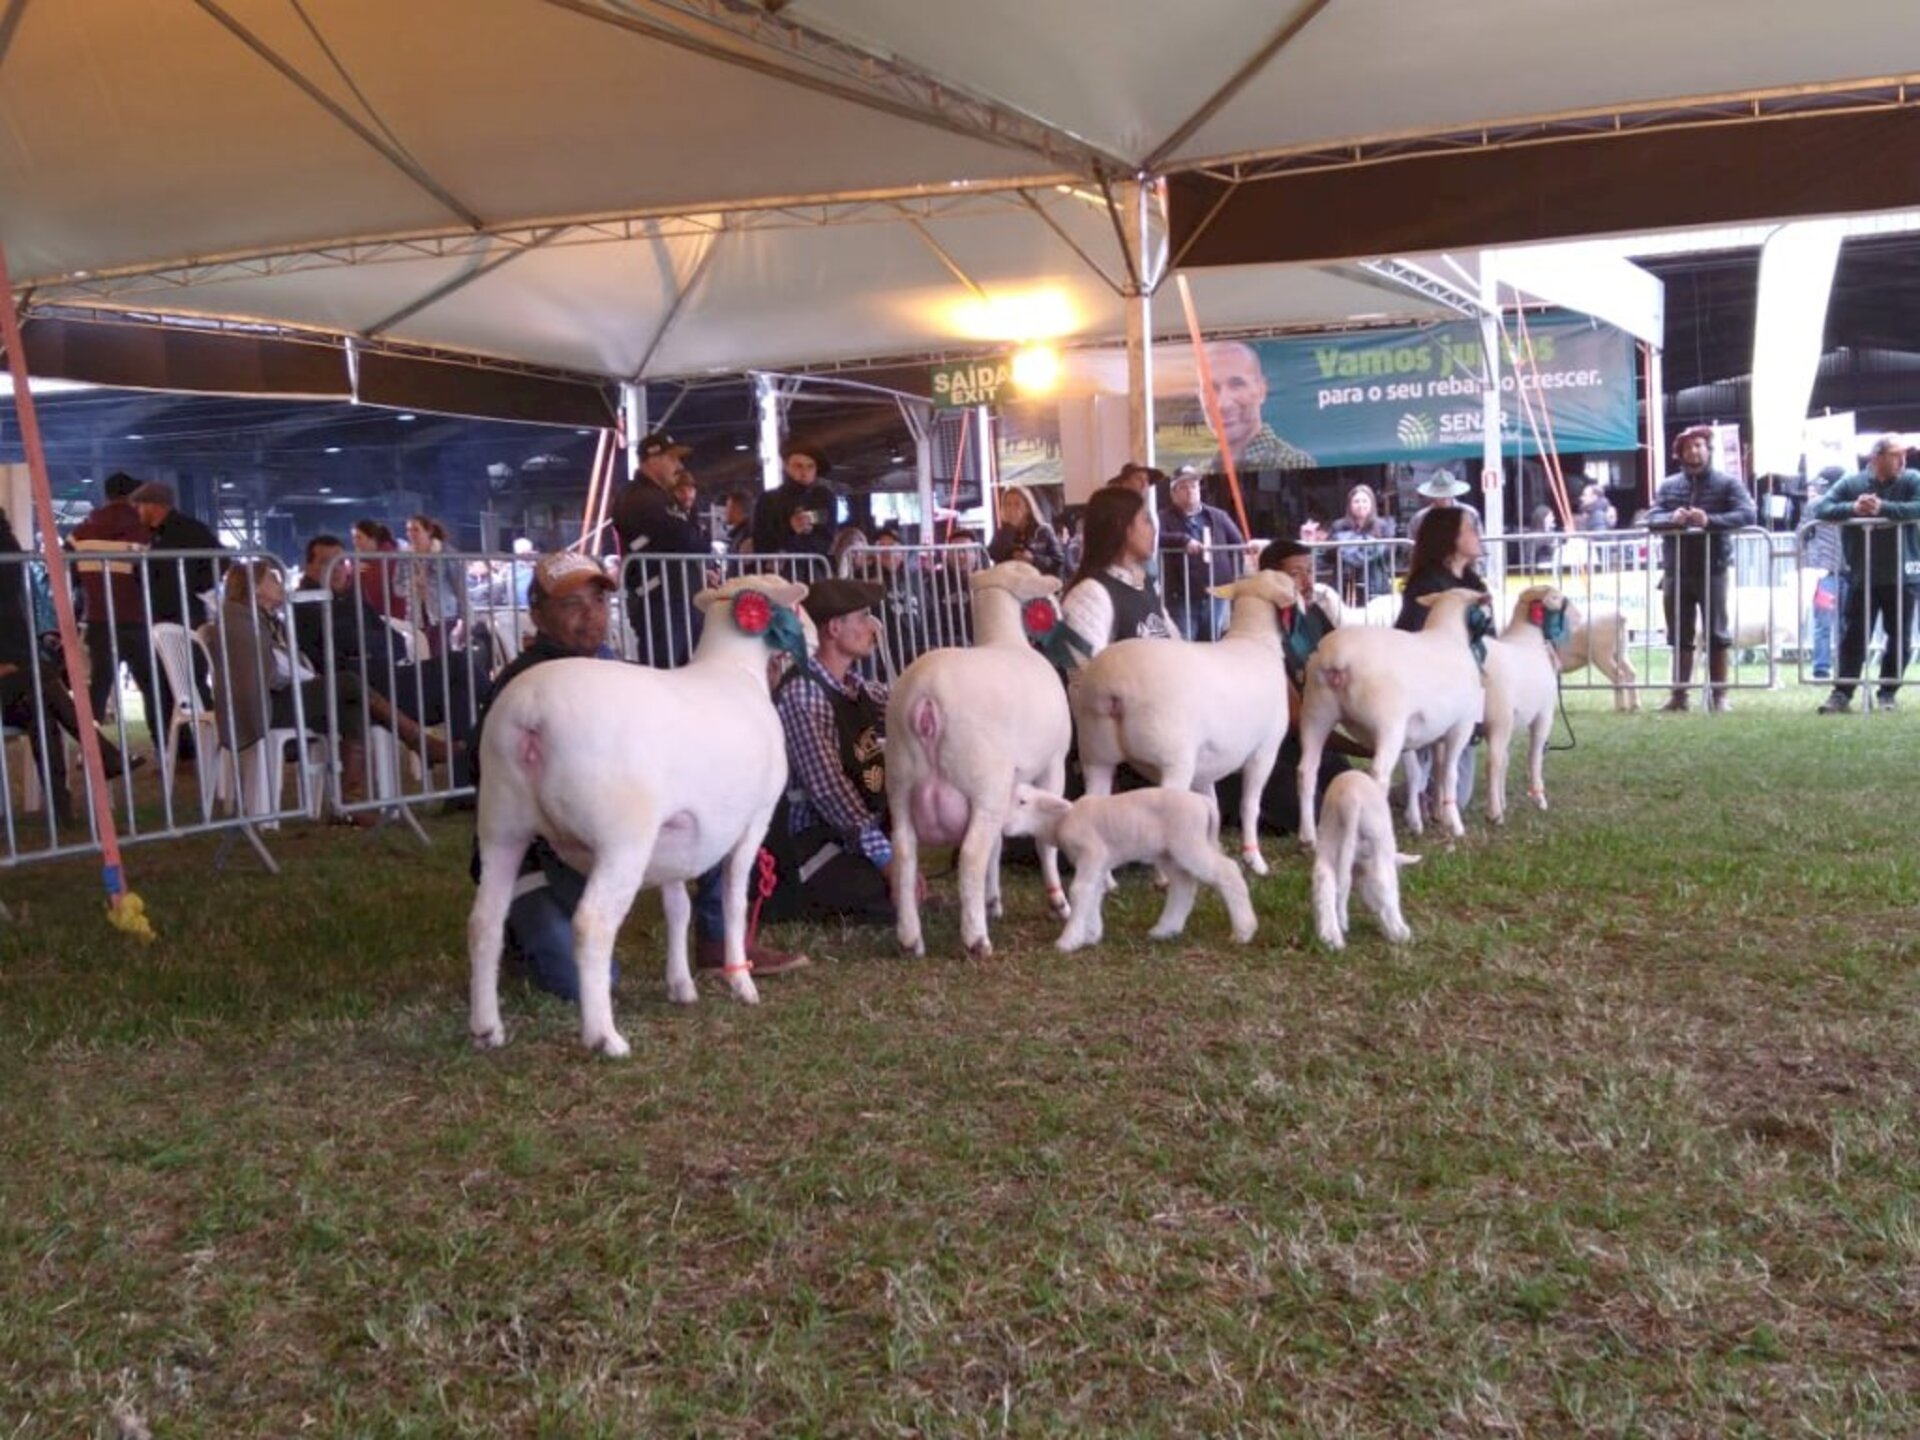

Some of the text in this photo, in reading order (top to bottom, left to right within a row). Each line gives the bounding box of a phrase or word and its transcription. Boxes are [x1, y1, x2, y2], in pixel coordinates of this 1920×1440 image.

[1315, 345, 1432, 379] Vamos
[951, 387, 998, 405] EXIT
[1318, 369, 1603, 410] para o seu rebao crescer.
[1440, 411, 1509, 432] SENR
